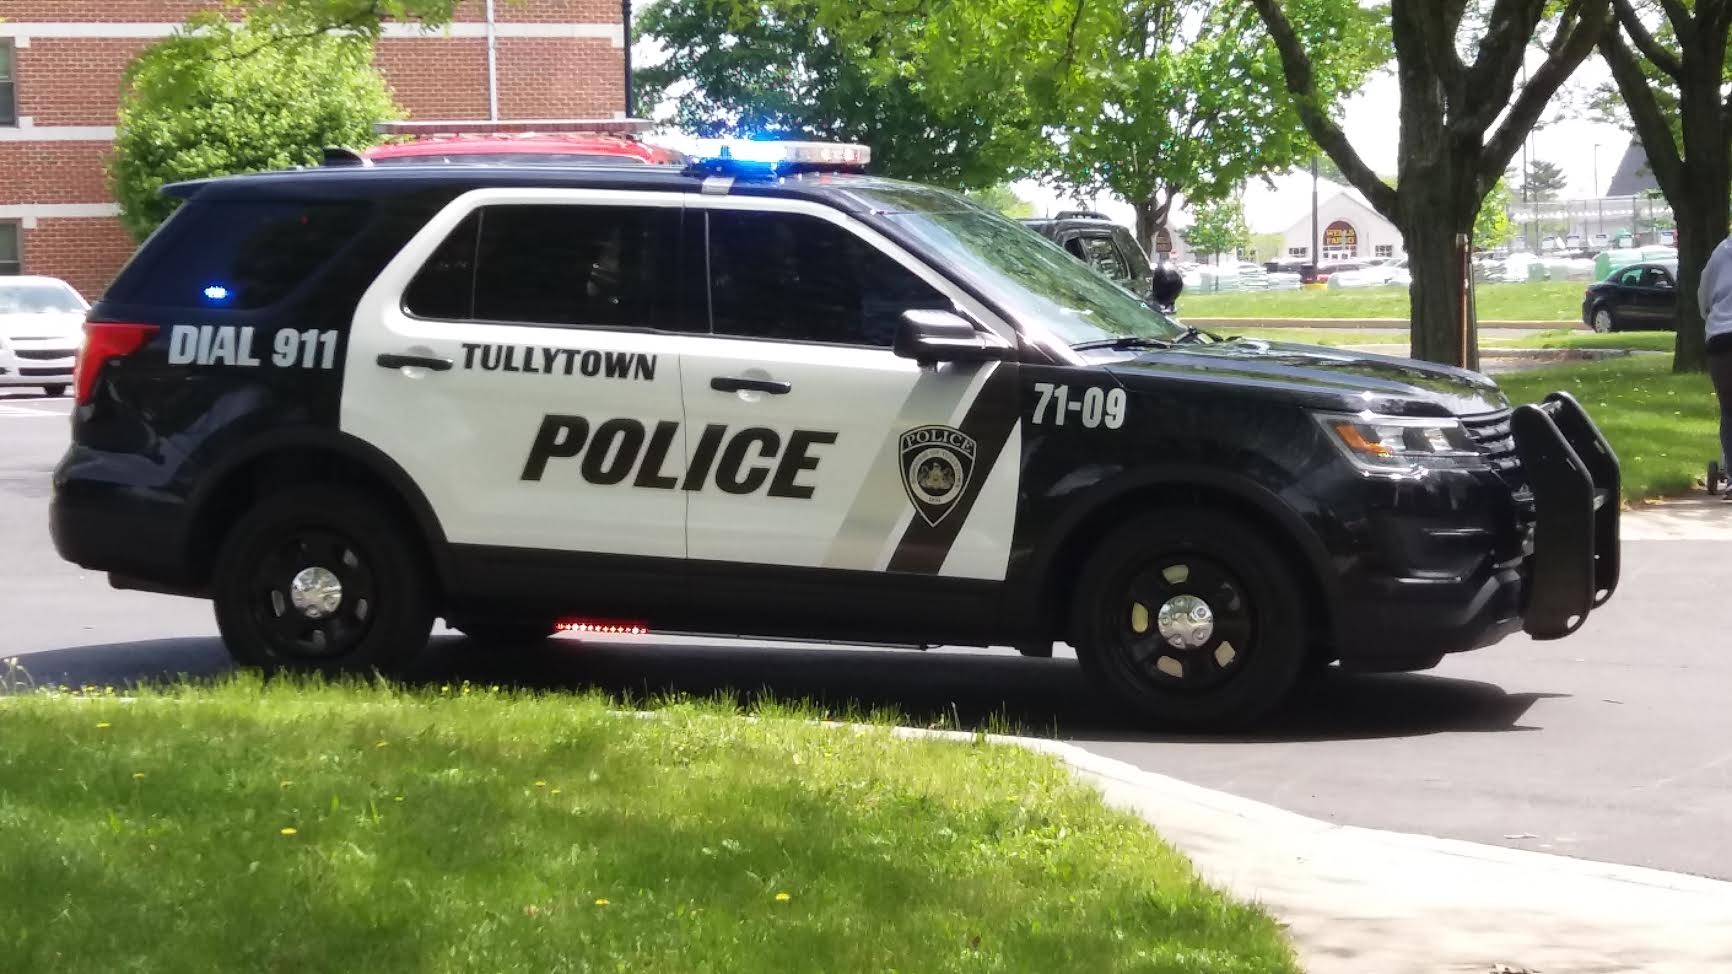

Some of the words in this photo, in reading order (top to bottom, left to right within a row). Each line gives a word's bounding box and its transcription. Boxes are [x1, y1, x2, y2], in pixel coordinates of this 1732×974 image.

[168, 324, 260, 366] DIAL
[271, 327, 338, 369] 911
[461, 343, 657, 381] TULLYTOWN
[1031, 382, 1127, 430] 71-09
[520, 414, 839, 500] POLICE
[905, 429, 973, 452] POLICE
